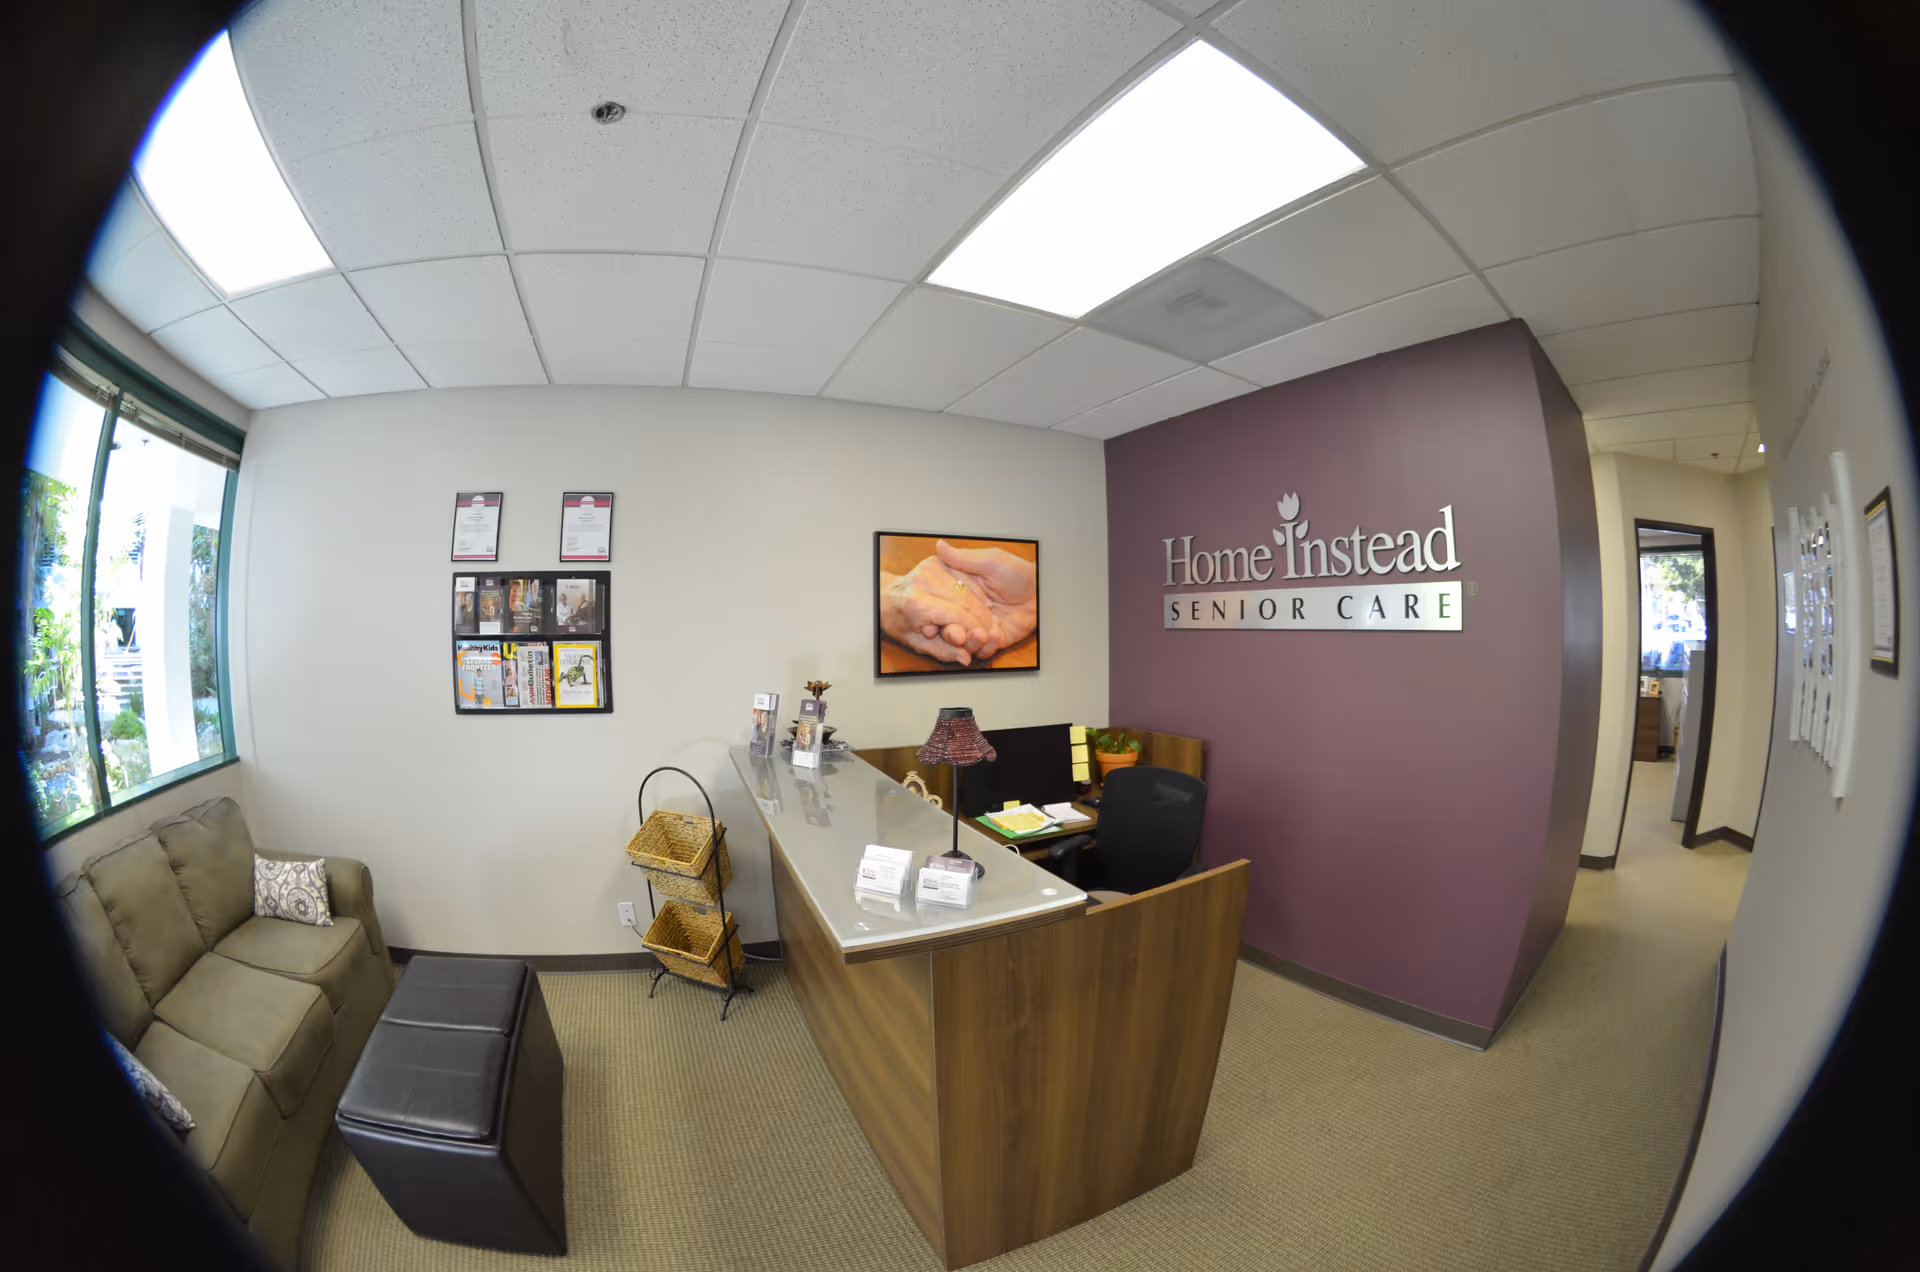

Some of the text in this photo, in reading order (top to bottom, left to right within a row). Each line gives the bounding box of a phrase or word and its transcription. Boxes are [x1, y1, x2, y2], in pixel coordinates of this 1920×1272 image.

[1162, 504, 1462, 586] Home Instead
[1170, 593, 1451, 622] SENIOR CARE
[457, 644, 499, 653] HlthyKids
